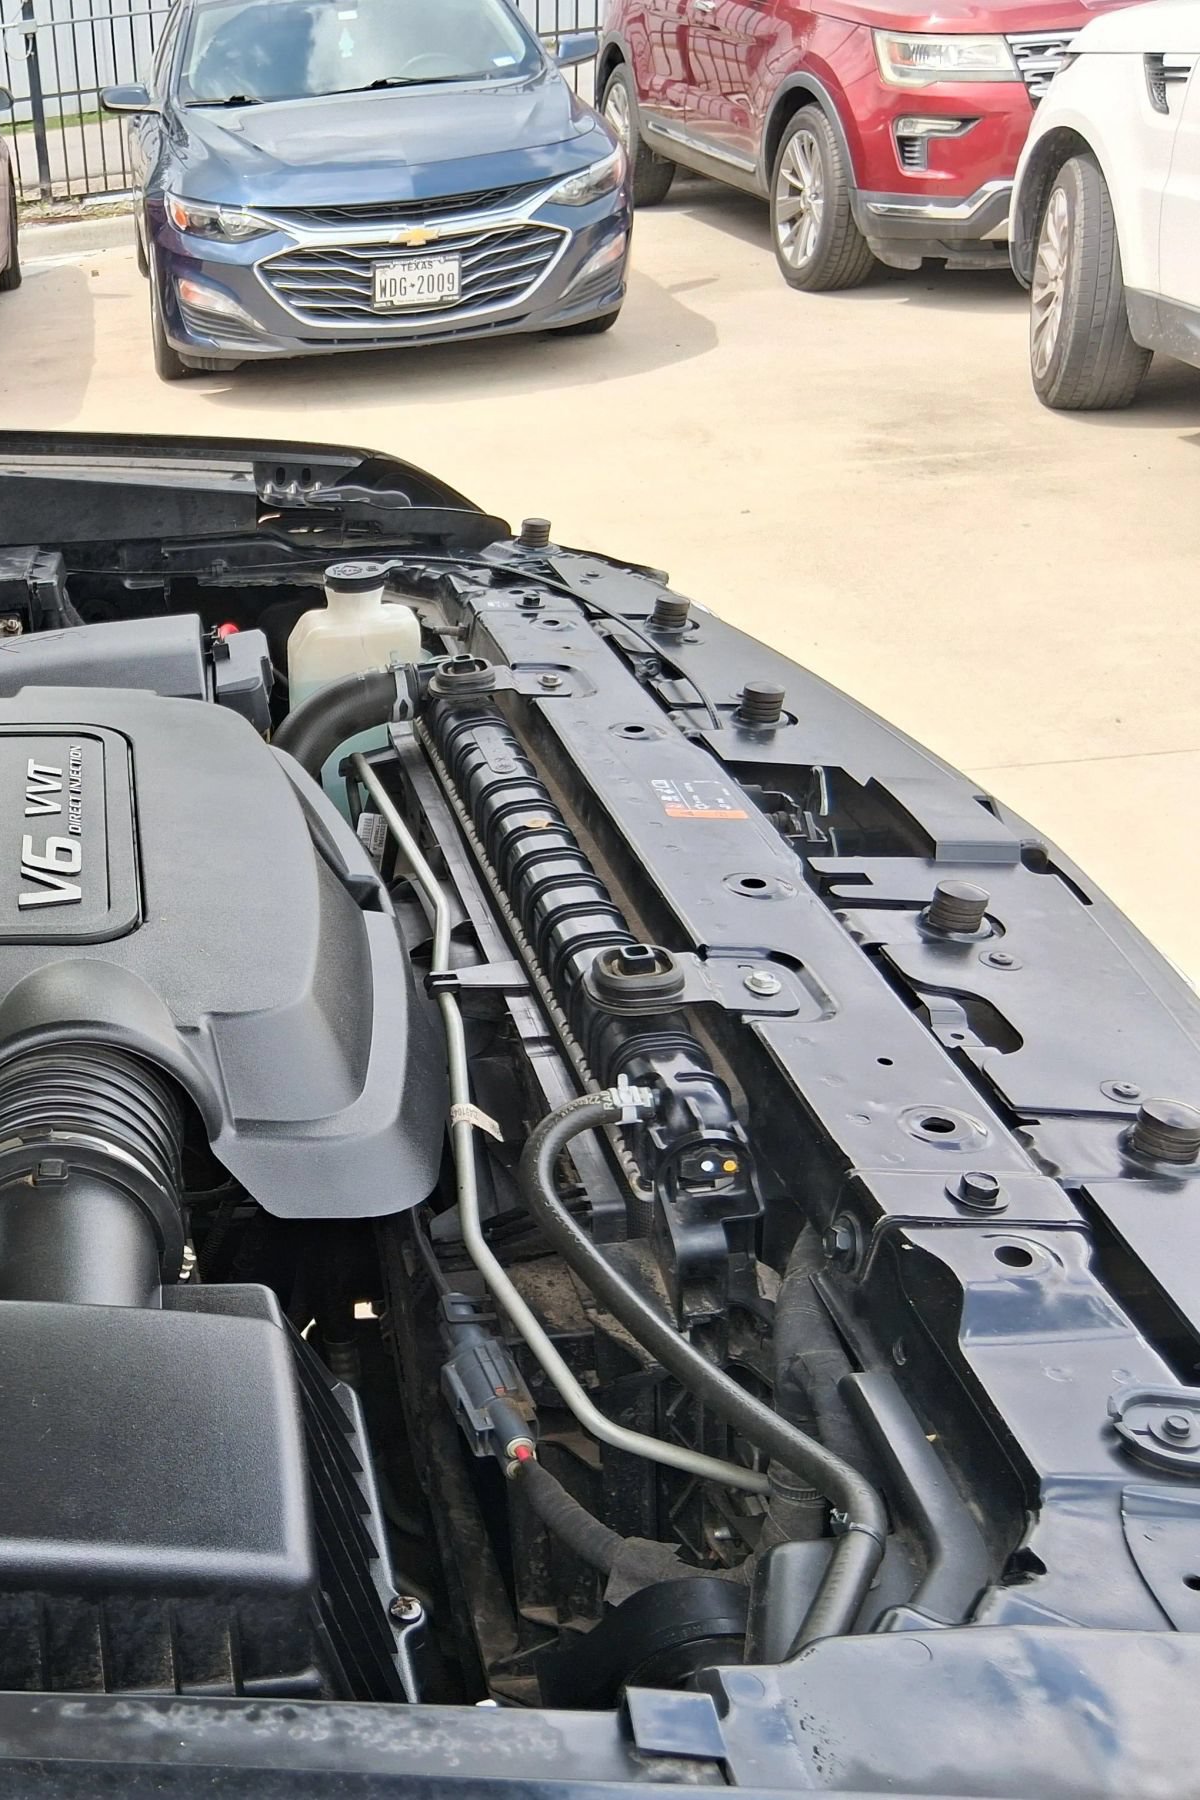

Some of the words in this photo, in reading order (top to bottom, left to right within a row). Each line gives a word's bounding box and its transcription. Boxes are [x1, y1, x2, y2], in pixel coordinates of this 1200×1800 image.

[402, 261, 434, 272] TEXAS
[25, 758, 63, 817] VVT
[69, 745, 82, 793] INJECTION
[69, 793, 82, 836] DIRECT
[18, 835, 82, 910] V6
